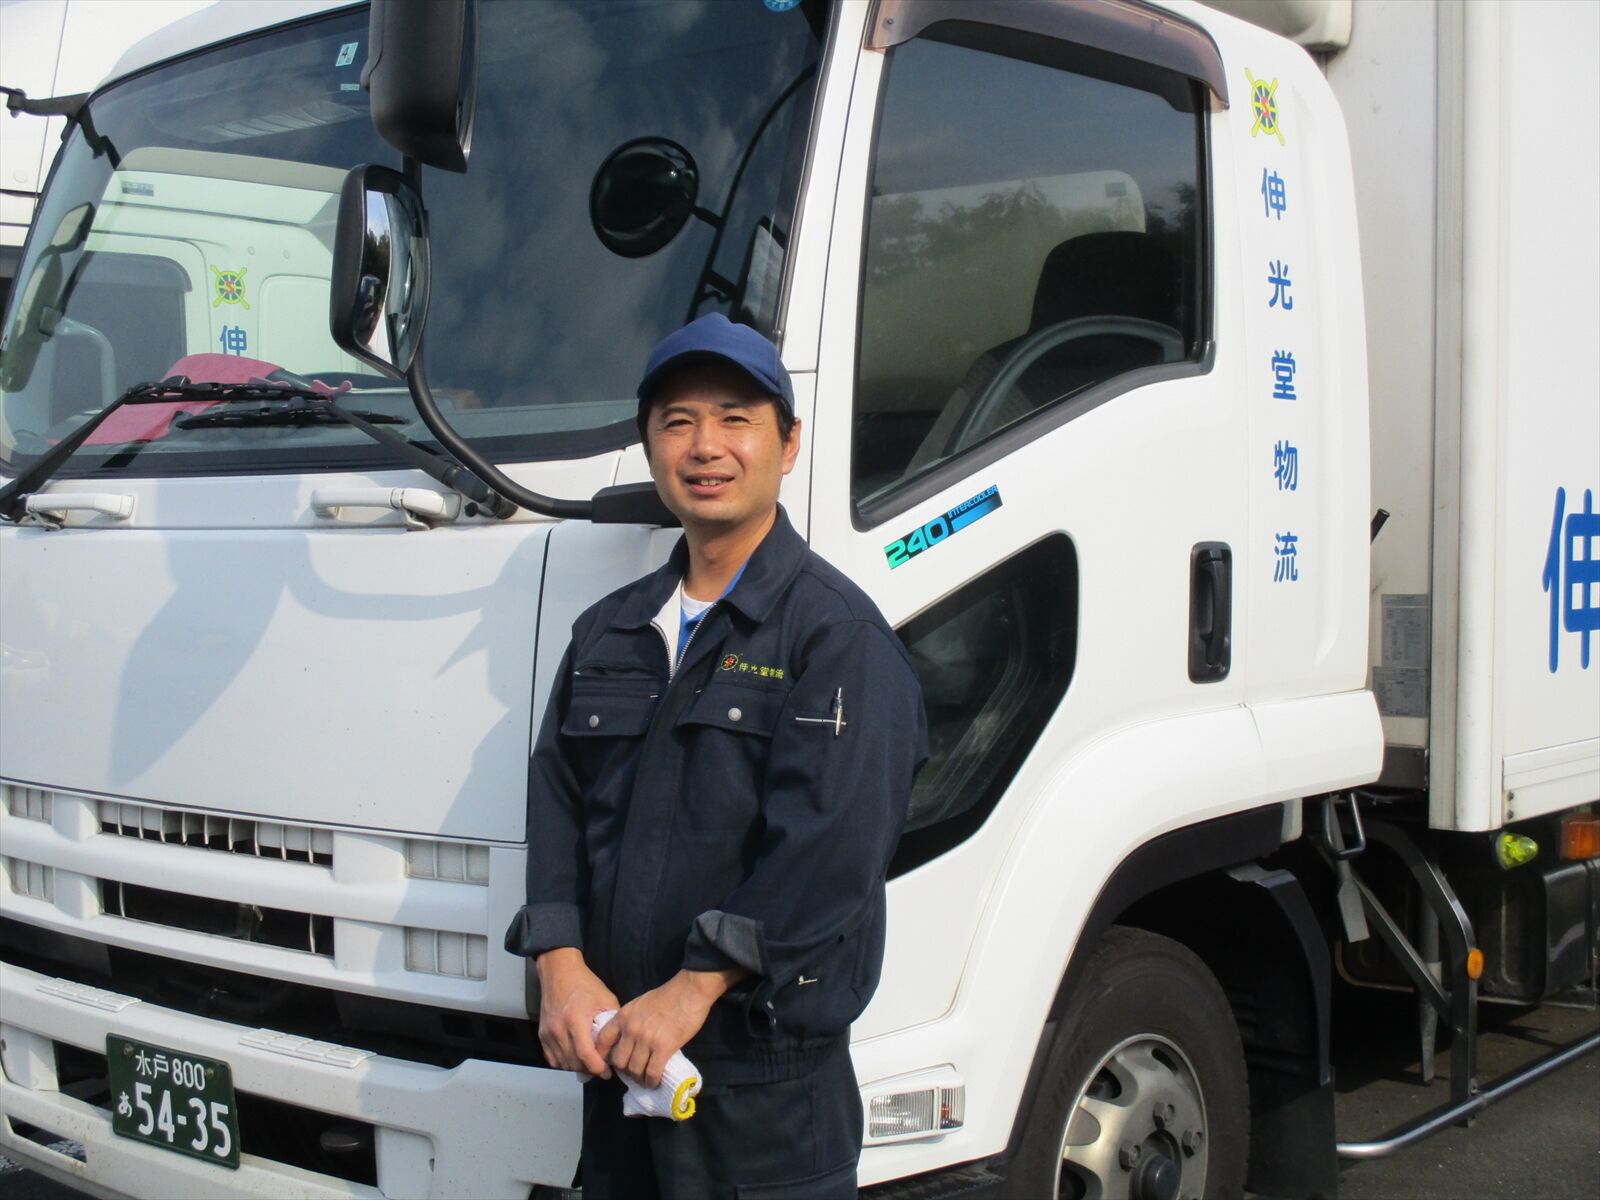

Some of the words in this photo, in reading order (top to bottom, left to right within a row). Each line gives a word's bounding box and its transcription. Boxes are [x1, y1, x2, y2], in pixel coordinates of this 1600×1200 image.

[219, 324, 248, 356] 伸
[1260, 166, 1299, 583] 伸光堂物流
[883, 517, 949, 570] 240
[1541, 485, 1600, 675] 伸
[135, 1049, 169, 1079] 水戸
[172, 1058, 205, 1090] 800
[118, 1090, 132, 1118] あ
[135, 1081, 231, 1157] 54-35
